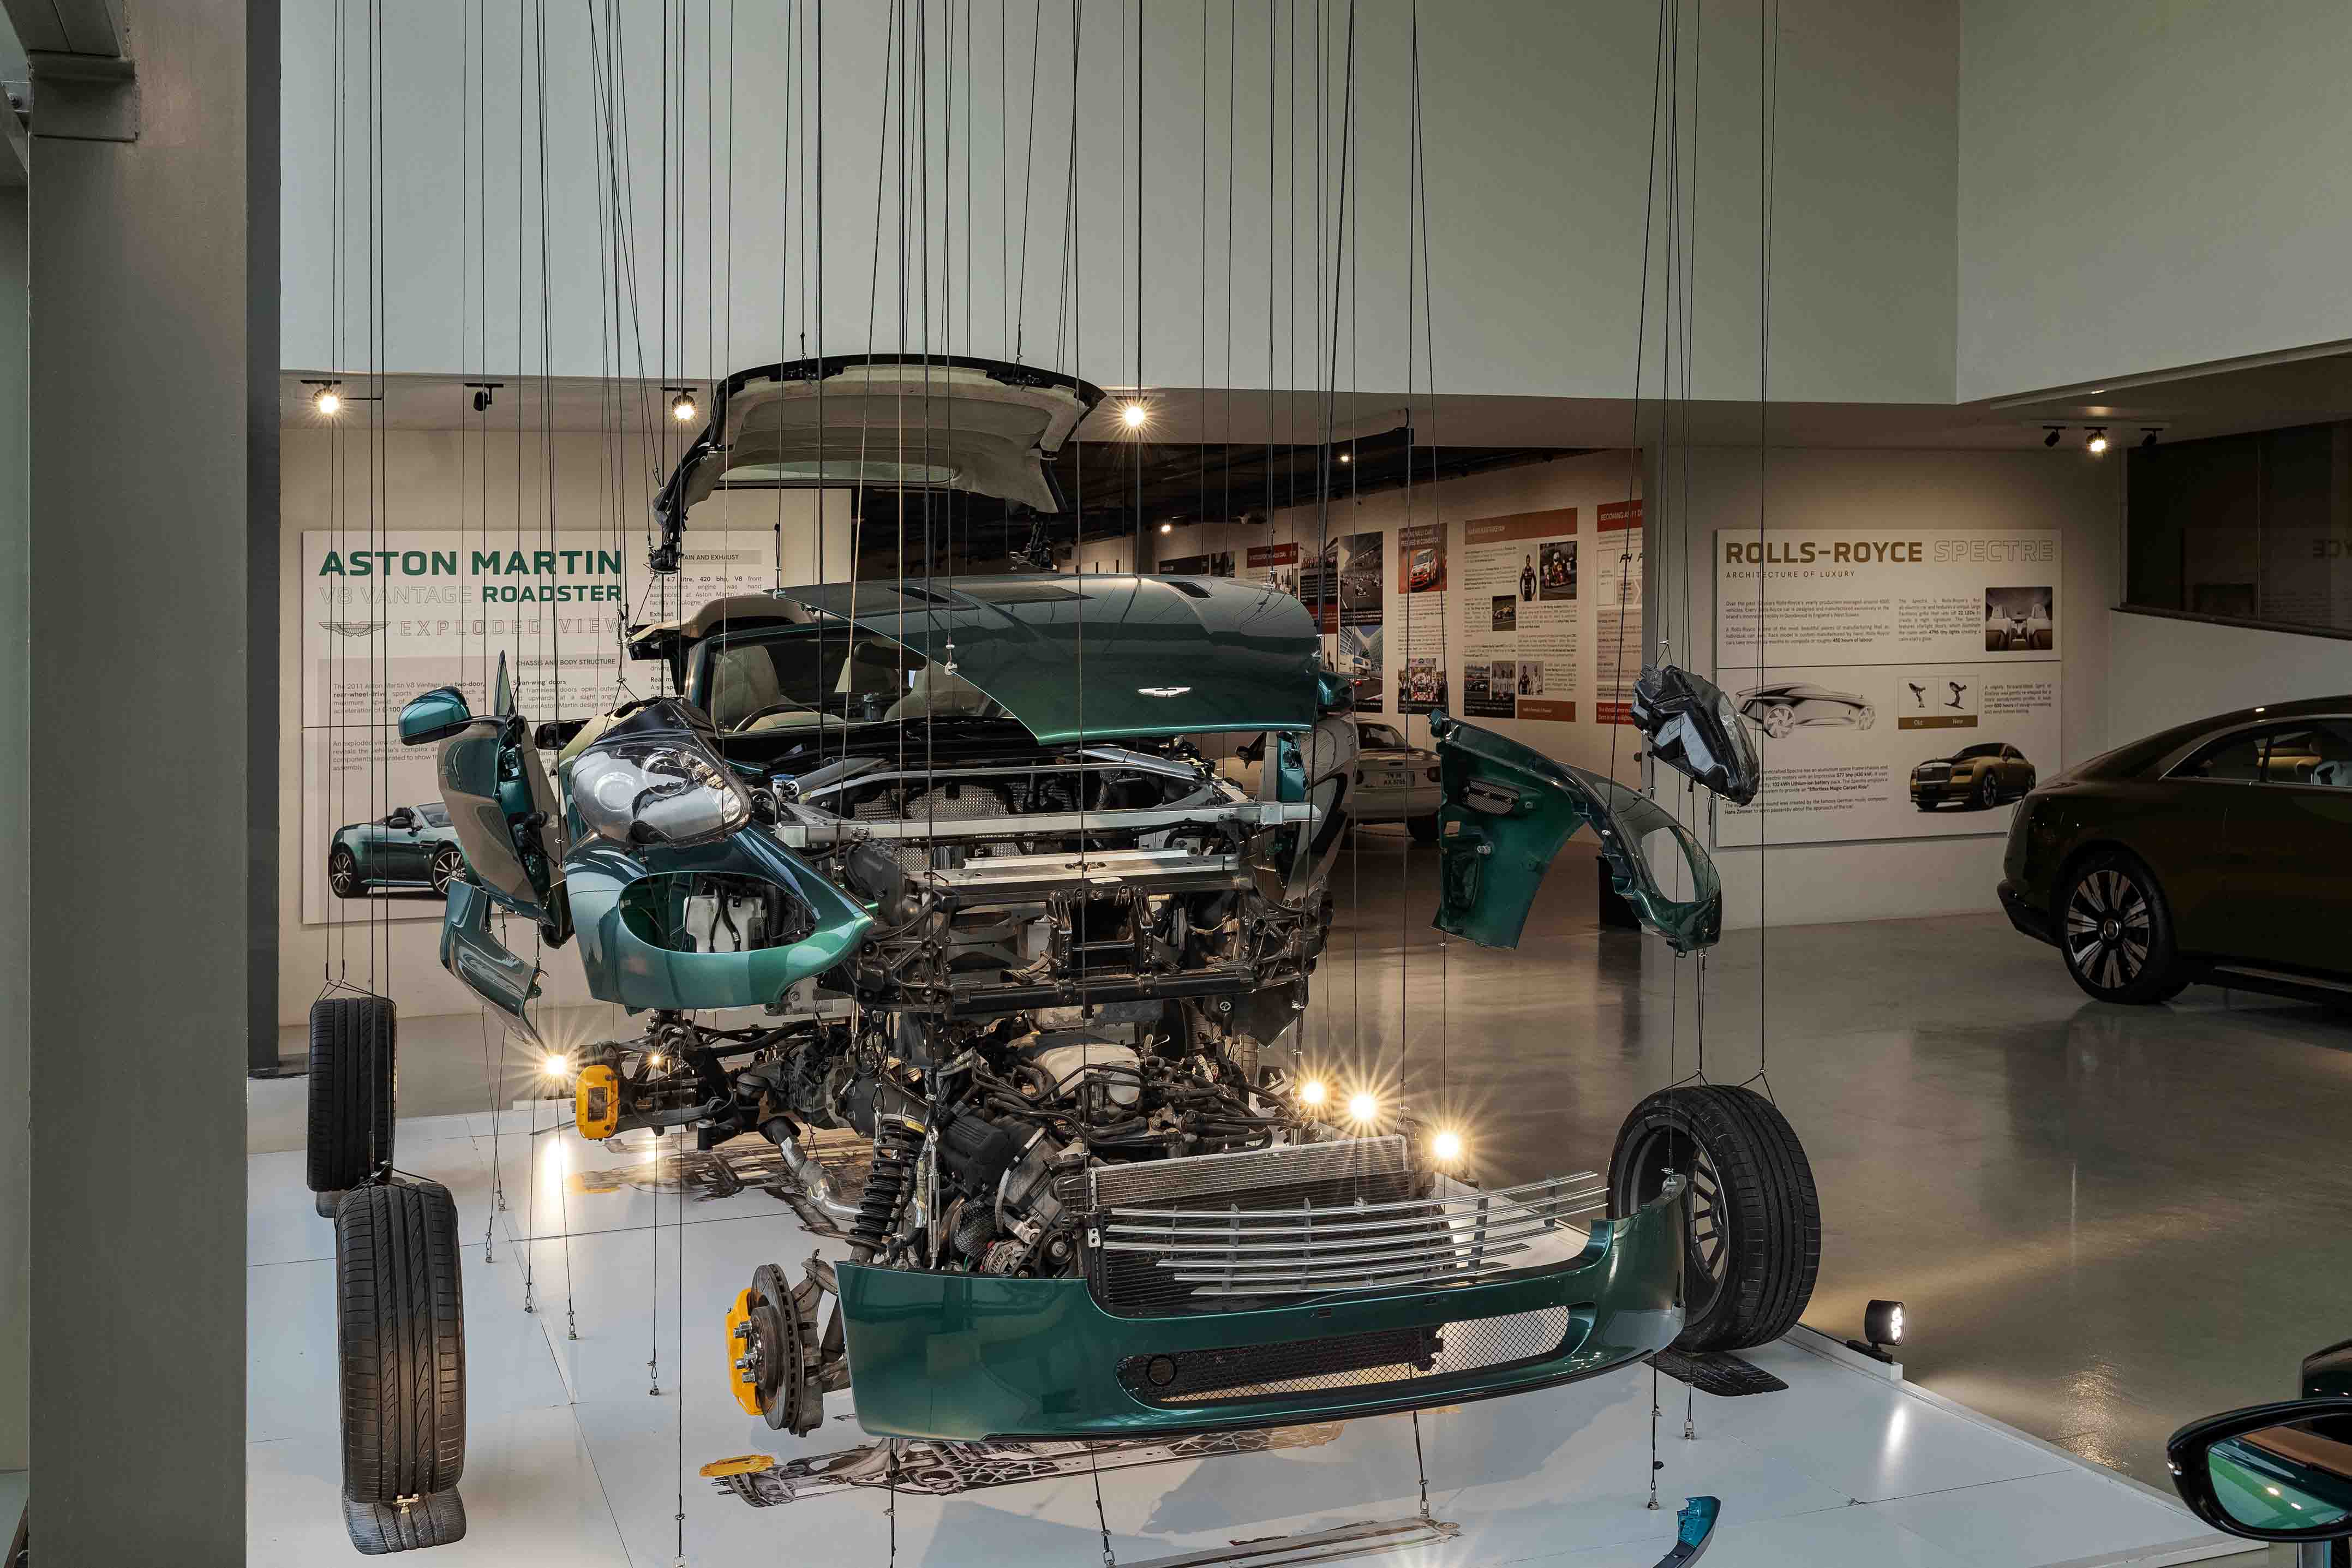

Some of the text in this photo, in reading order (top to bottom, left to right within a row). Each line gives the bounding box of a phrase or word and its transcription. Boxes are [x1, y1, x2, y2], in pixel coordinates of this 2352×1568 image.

[1726, 540, 2053, 563] ROLLS-ROYCE SPECTRE
[319, 550, 621, 576] ASTON MARTIN
[319, 585, 621, 605] V8 VANTAGE ROADSTER
[400, 618, 620, 636] EXPLODED VIEW
